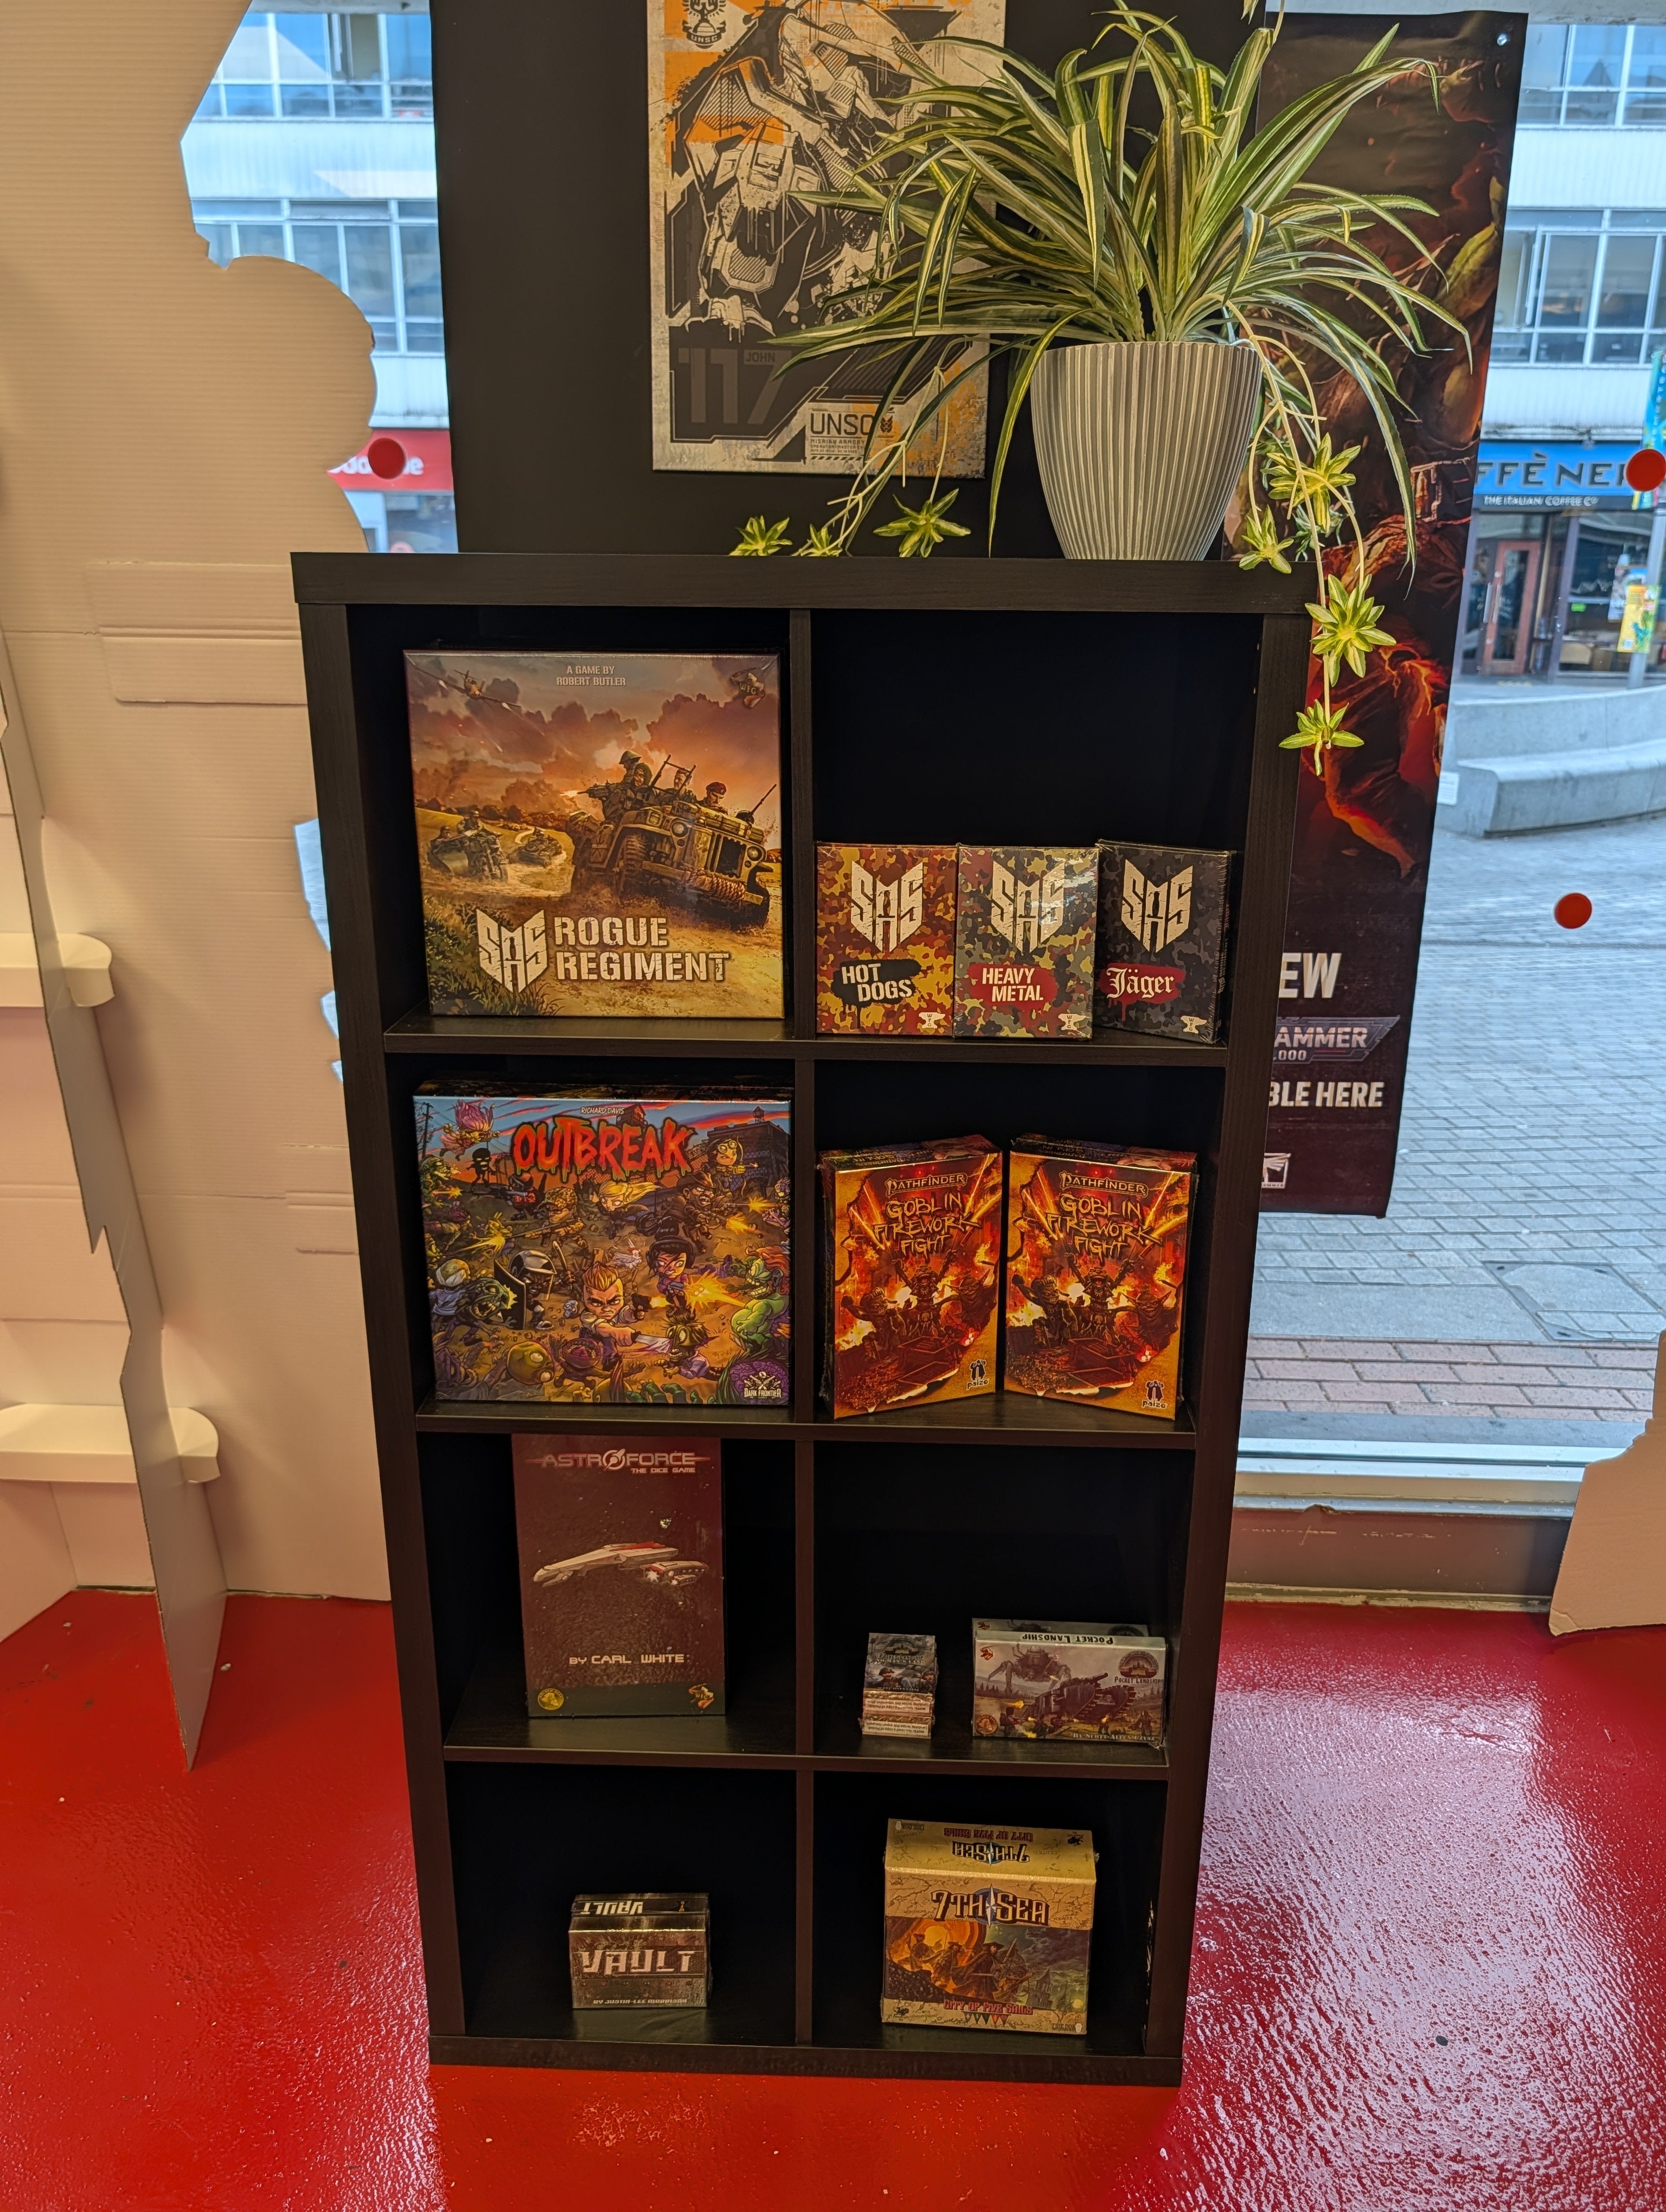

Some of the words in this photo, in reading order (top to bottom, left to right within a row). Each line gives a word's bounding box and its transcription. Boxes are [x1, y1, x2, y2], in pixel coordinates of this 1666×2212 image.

[690, 35, 718, 43] UNSC
[746, 352, 776, 363] JOHN
[678, 348, 792, 424] 117
[1484, 496, 1503, 505] THE
[1503, 496, 1543, 506] ITALIAN
[1545, 496, 1582, 506] COFFEE
[567, 666, 573, 674] A
[575, 666, 600, 674] GAME
[603, 666, 615, 674] BY
[556, 677, 591, 685] ROBERT
[593, 677, 626, 686] BUTLER
[739, 683, 756, 695] WFG
[851, 860, 924, 953] SAS
[991, 860, 1066, 954] SAS
[1121, 859, 1193, 953] SAS
[554, 916, 669, 947] ROGUE
[476, 909, 548, 993] SAS
[554, 951, 730, 982] REGIMENT
[842, 963, 881, 985] HOT
[982, 967, 1035, 985] HEAVY
[857, 979, 912, 1002] DOGS
[991, 985, 1044, 1002] METAL
[1106, 967, 1174, 999] Jäger
[1315, 1081, 1385, 1108] HERE
[511, 1117, 695, 1182] OUTBREAK
[886, 1174, 966, 1196] PATHFINDER
[1061, 1172, 1146, 1196] PATHFINDER
[886, 1191, 963, 1221] GOBLIN
[1061, 1193, 1142, 1221] GOBLIN
[872, 1213, 982, 1240] FIREWORK
[1046, 1213, 1162, 1245] FIREWORK
[901, 1234, 951, 1260] FIGHT
[1074, 1235, 1128, 1262] FIGHT
[744, 1388, 757, 1397] DARK
[758, 1388, 781, 1398] FRONTIER
[967, 1379, 988, 1389] paizo
[1143, 1400, 1166, 1409] paizo
[1022, 1634, 1071, 1643] LANDSHIP
[1075, 1636, 1114, 1644] POCKET
[569, 1657, 587, 1665] BY
[592, 1655, 632, 1664] CARL
[641, 1654, 685, 1663] WHITE
[1011, 1832, 1033, 1842] CITY
[952, 1840, 987, 1862] SEA
[995, 1842, 1030, 1863] 7TH
[579, 1900, 644, 1915] VAULT
[931, 1889, 987, 1922] 7TH
[996, 1892, 1050, 1927] SEA
[577, 1950, 697, 1976] VAULT
[944, 1999, 965, 2010] CITY
[968, 2001, 982, 2011] OF
[983, 2001, 1003, 2012] FIVE
[1005, 2004, 1033, 2015] SAILS
